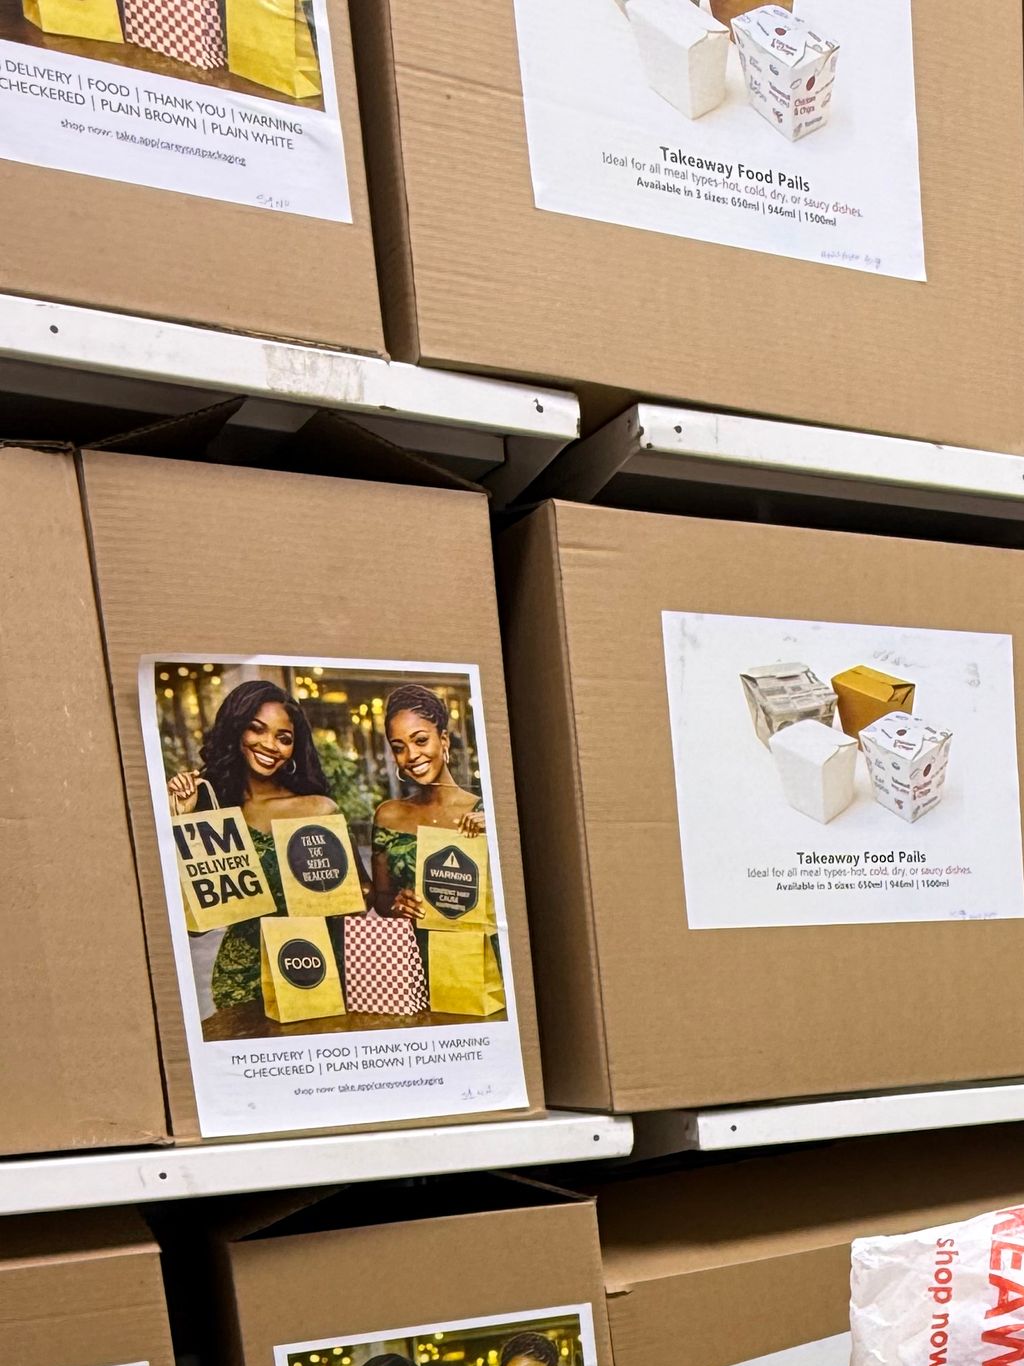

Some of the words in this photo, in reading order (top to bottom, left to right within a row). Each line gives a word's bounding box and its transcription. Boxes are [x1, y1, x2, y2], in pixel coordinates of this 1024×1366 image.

[5, 59, 72, 85] DELIVERY
[88, 78, 130, 97] FOOD
[144, 90, 194, 112] THANK
[196, 101, 226, 118] YOU
[238, 111, 303, 134] WARNING
[0, 77, 86, 105] CHECKERED
[101, 98, 140, 118] PLAIN
[145, 108, 197, 130] BROWN
[212, 122, 248, 140] PLAIN
[252, 131, 294, 150] WHITE
[61, 118, 85, 133] shop
[602, 152, 628, 168] Ideal
[631, 157, 647, 172] for
[650, 163, 660, 176] all
[664, 167, 688, 180] meal
[744, 185, 768, 199] cold,
[770, 189, 788, 204] dry,
[791, 196, 801, 204] or
[804, 196, 830, 214] saucy
[660, 146, 733, 179] Takeaway
[738, 164, 773, 184] Food
[778, 172, 810, 192] Pails
[636, 176, 681, 196] Available
[684, 186, 694, 198] in
[768, 204, 796, 219] 946ml
[805, 212, 836, 227] 1500ml
[172, 817, 246, 860] I'M
[186, 854, 250, 878] DELIVERY
[747, 867, 769, 878] Ideal
[772, 866, 784, 878] for
[787, 867, 798, 877] all
[800, 867, 822, 877] meal
[910, 868, 918, 876] or
[796, 851, 860, 867] Takeaway
[864, 850, 894, 864] Food
[898, 850, 926, 863] Pails
[192, 869, 264, 909] BAG
[430, 868, 472, 882] WARNING
[776, 882, 815, 890] Available
[284, 956, 322, 971] FOOD
[244, 1064, 314, 1079] CHECKERED
[326, 1060, 359, 1072] PLAIN
[362, 1057, 404, 1070] BROWN
[415, 1054, 446, 1066] PLAIN
[448, 1050, 483, 1062] WHITE
[250, 1050, 304, 1064] DELIVERY
[316, 1047, 350, 1059] FOOD
[362, 1043, 402, 1056] THANK
[404, 1041, 428, 1052] YOU
[438, 1036, 490, 1049] WARNING
[928, 1238, 959, 1304] shop
